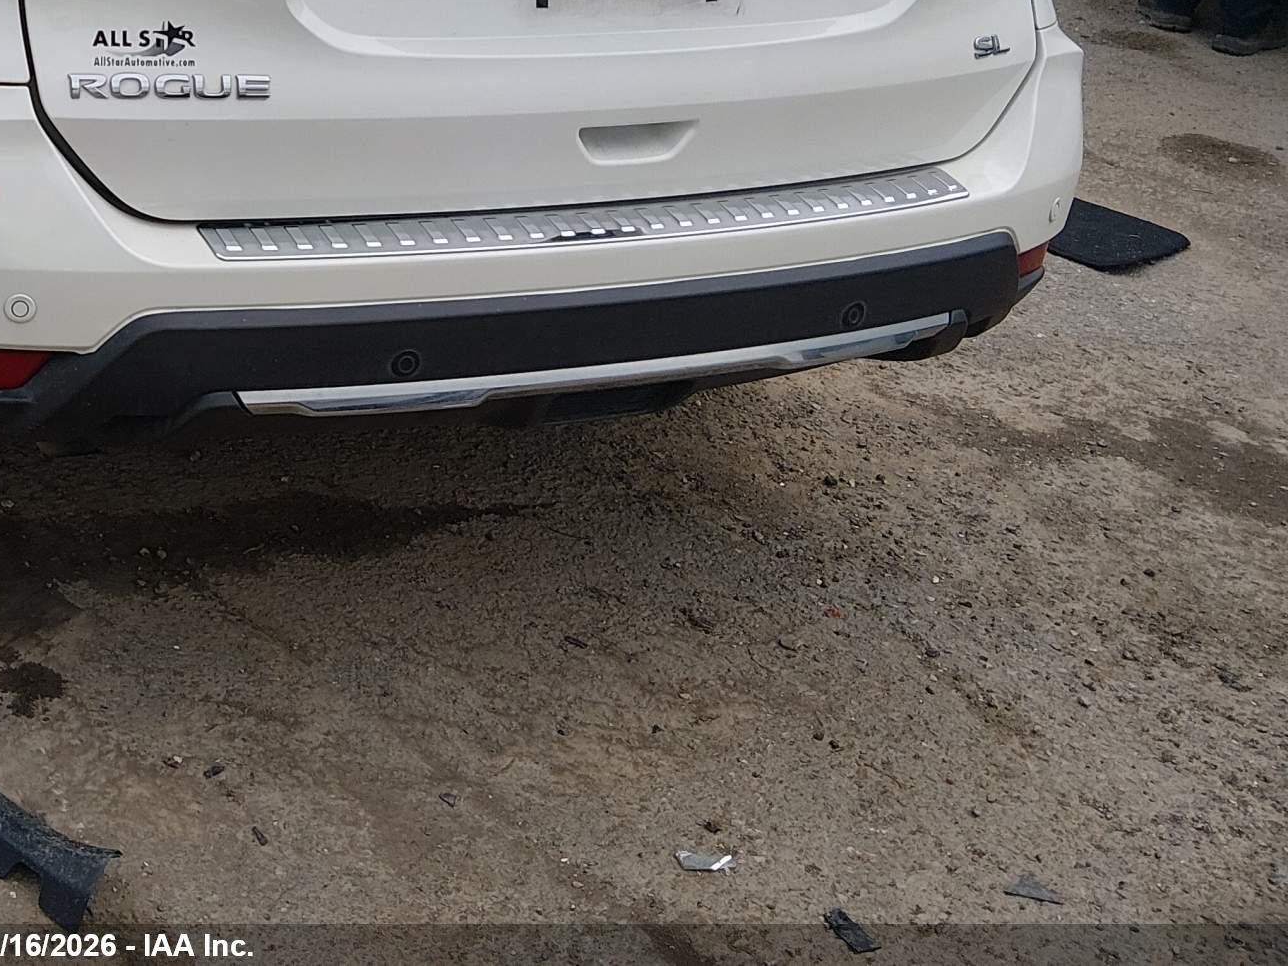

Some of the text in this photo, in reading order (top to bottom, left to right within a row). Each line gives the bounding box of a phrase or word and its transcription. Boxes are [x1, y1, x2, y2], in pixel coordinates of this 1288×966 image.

[92, 30, 132, 47] ALL
[973, 34, 1010, 59] SL
[93, 56, 196, 68] AllStarAutomotive.com
[67, 72, 272, 99] ROGUE
